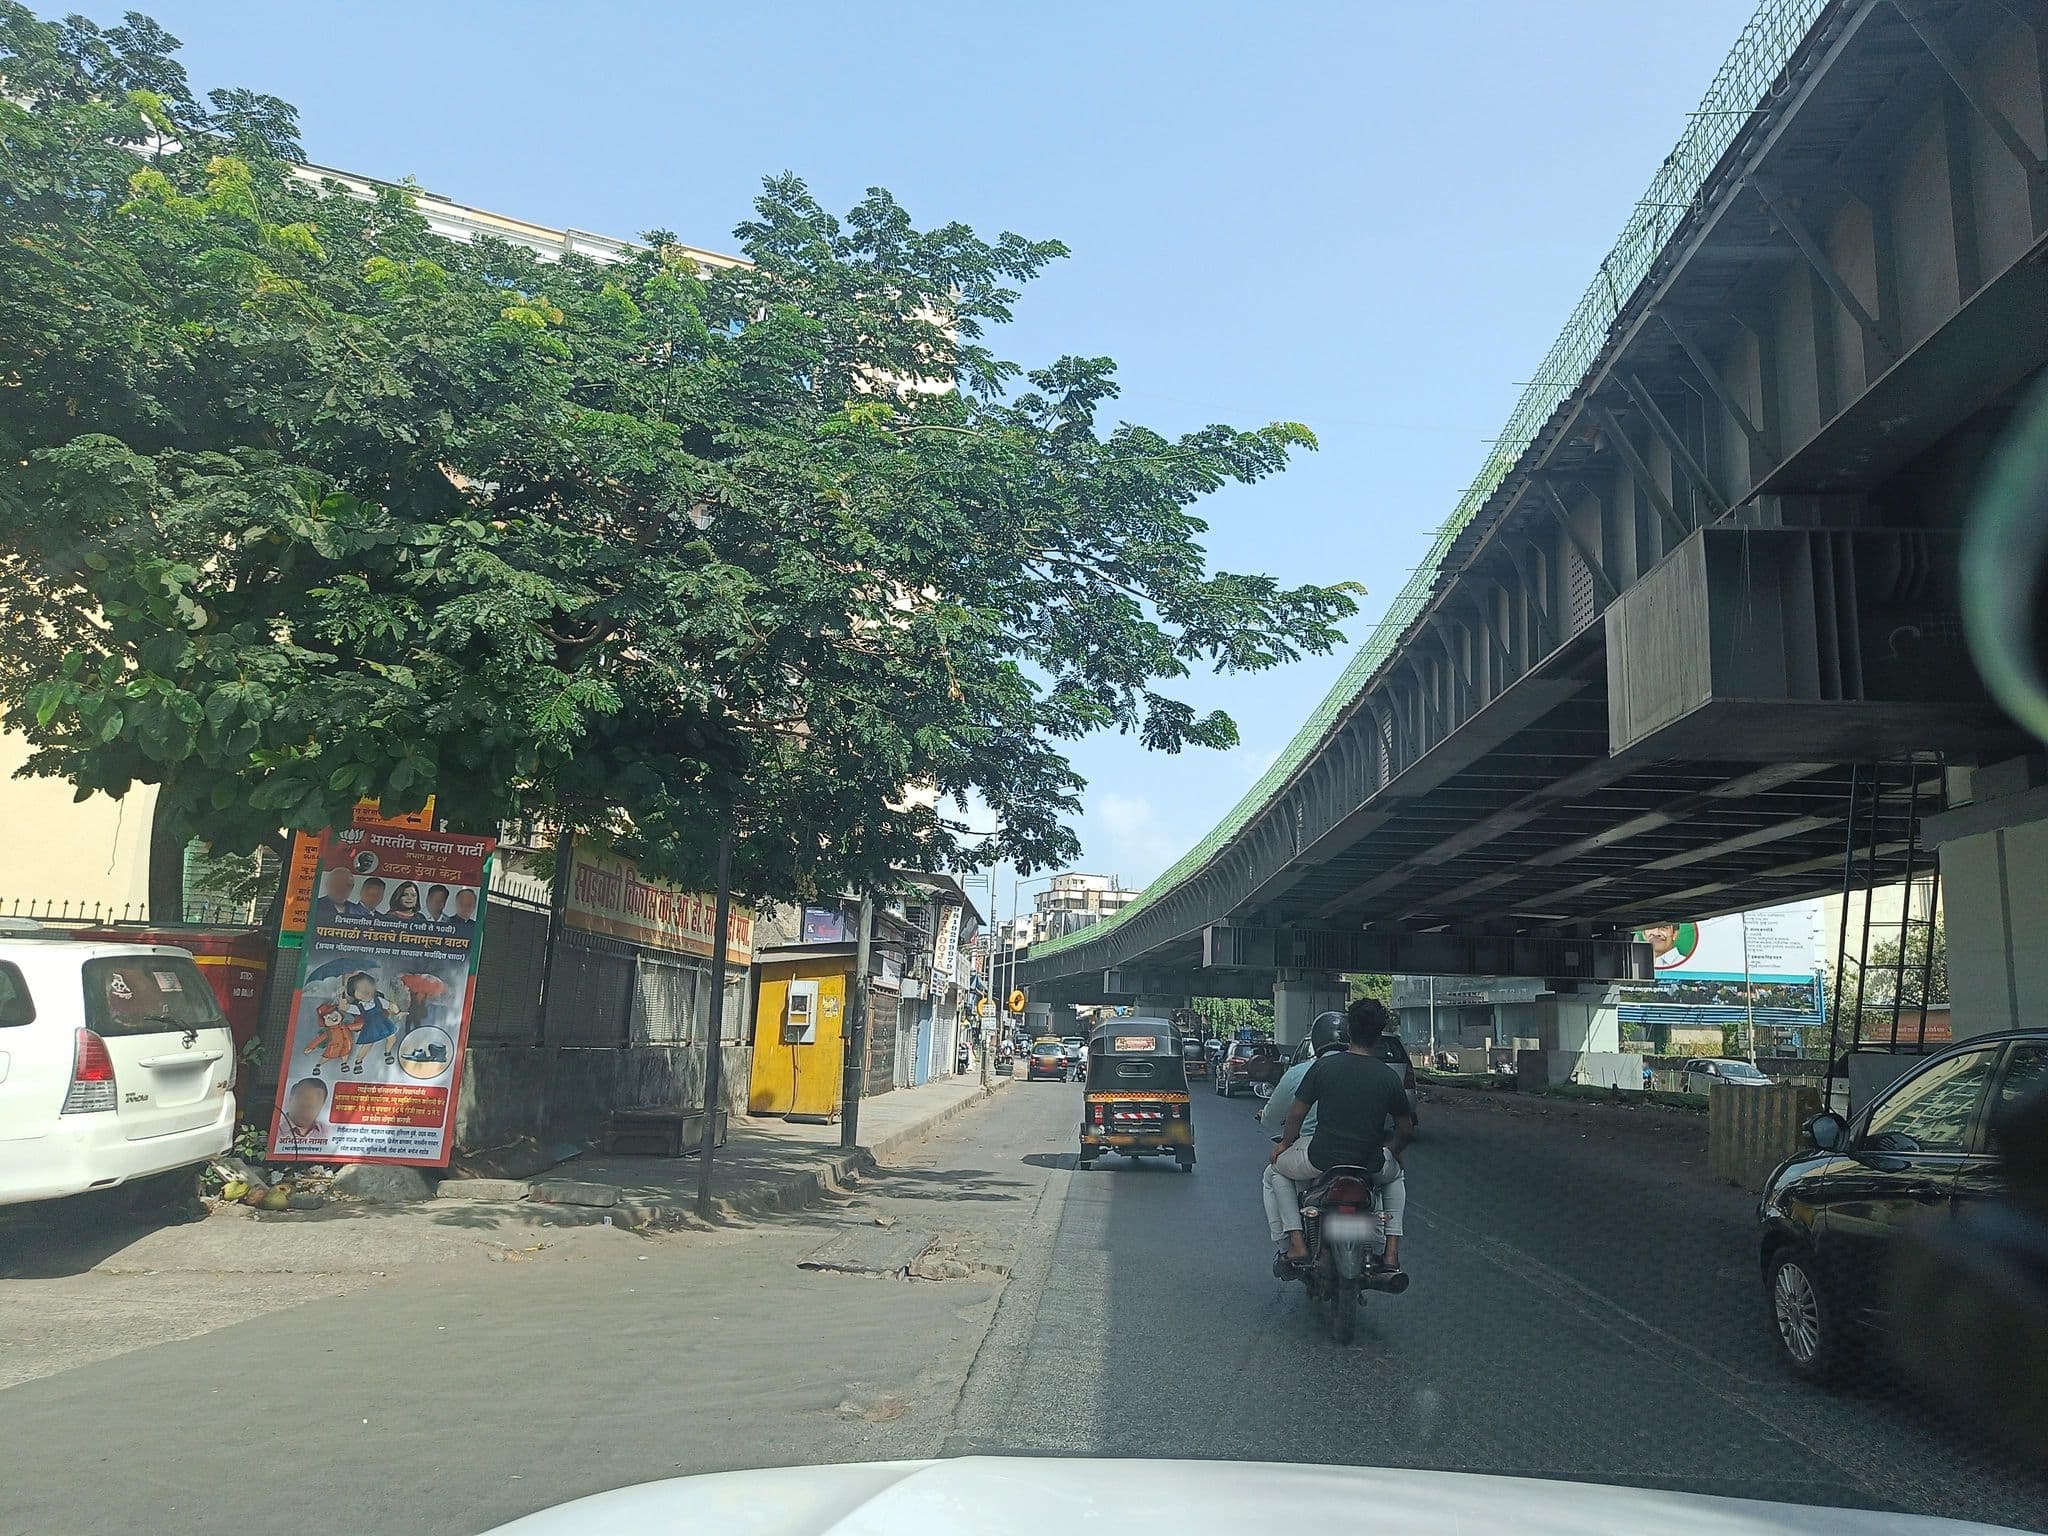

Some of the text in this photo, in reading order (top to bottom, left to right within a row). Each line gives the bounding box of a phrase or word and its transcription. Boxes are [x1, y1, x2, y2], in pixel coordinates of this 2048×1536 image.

[370, 833, 485, 857] भारतीय जनता पार्टी
[382, 862, 411, 875] अटल
[414, 862, 436, 877] सेवा
[316, 926, 361, 940] पावसाळी
[399, 931, 442, 949] विनामूल्य
[444, 937, 470, 949] वाटप
